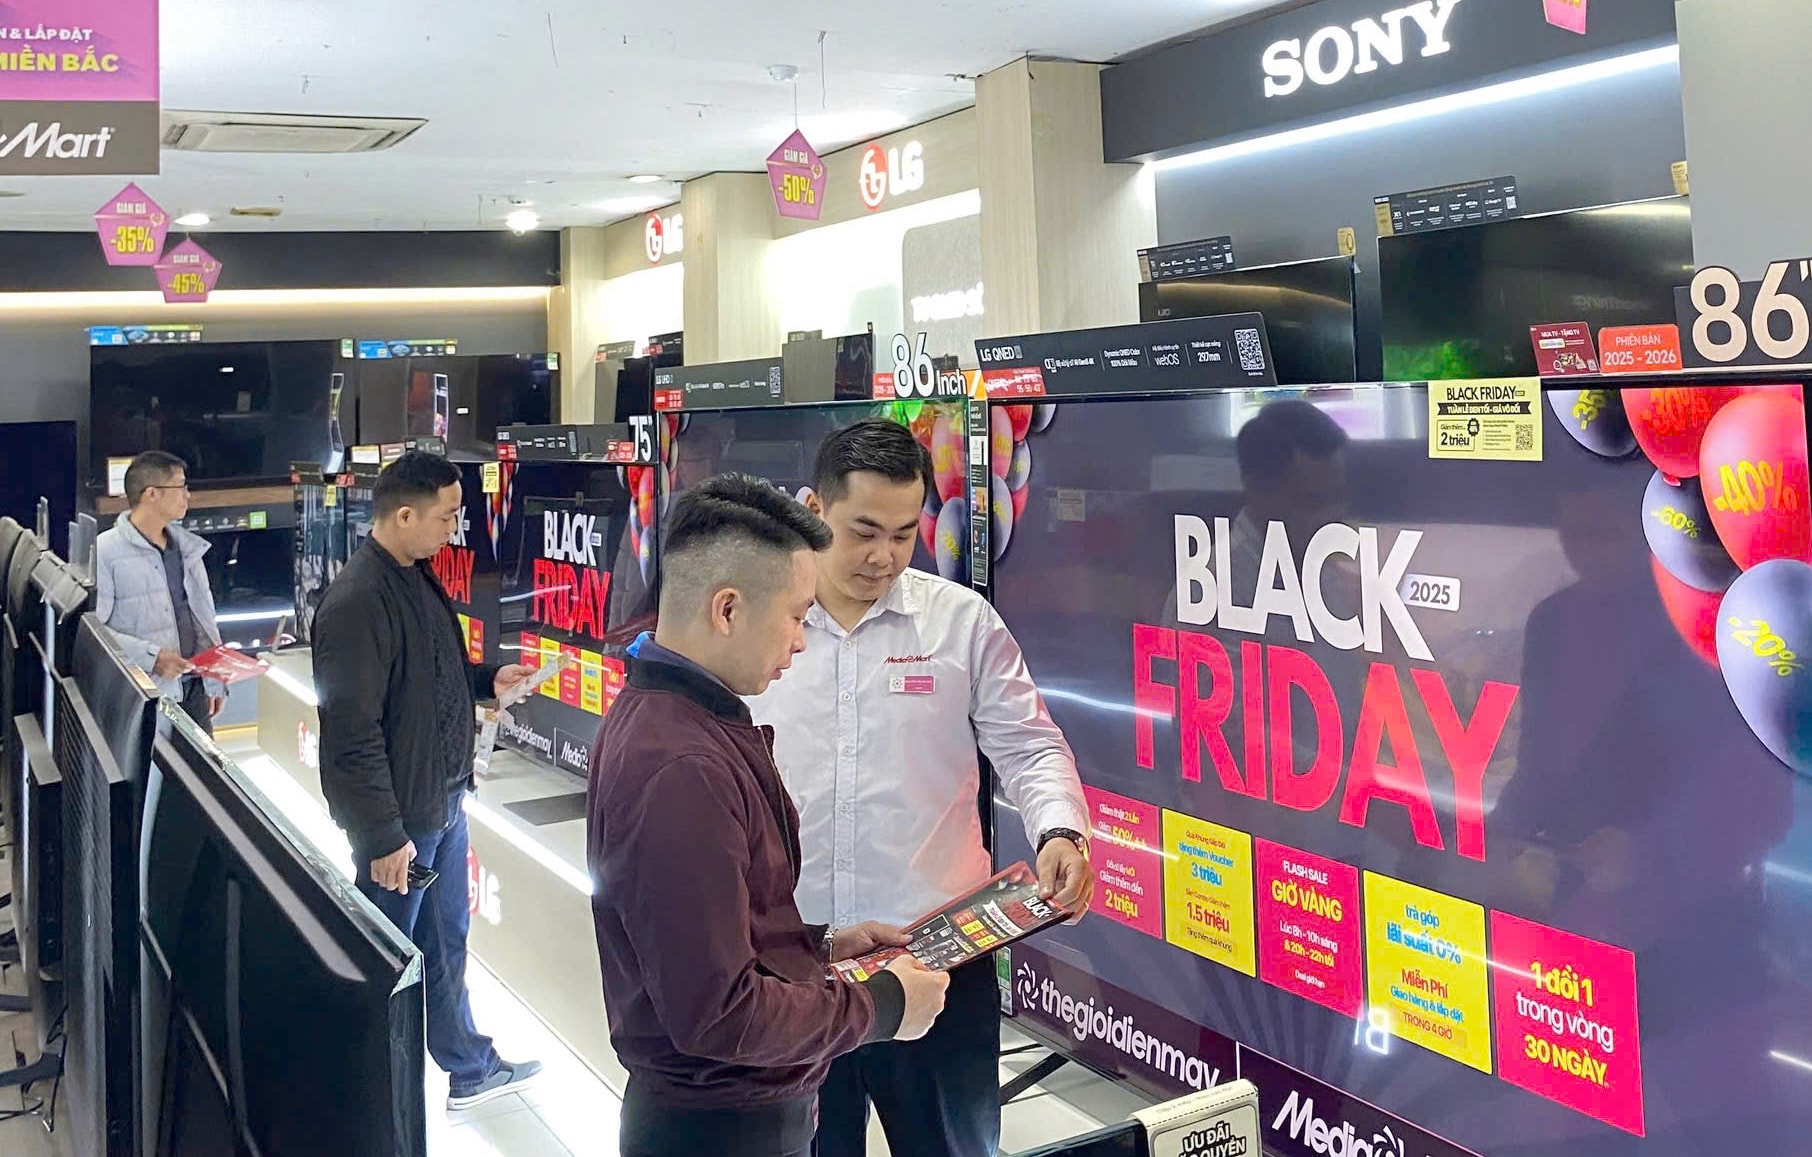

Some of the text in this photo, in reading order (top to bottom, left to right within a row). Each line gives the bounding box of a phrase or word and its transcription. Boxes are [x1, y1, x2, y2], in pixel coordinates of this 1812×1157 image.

[25, 23, 57, 40] LẮP
[58, 26, 93, 44] ĐẶT
[1262, 0, 1461, 97] SONY
[62, 45, 119, 72] BẮC
[0, 122, 112, 158] Mart
[889, 140, 924, 196] LG
[778, 173, 816, 205] -50%
[109, 226, 154, 253] -35%
[167, 273, 205, 294] -45%
[980, 346, 1014, 362] LG QNED
[1615, 332, 1661, 346] PHIÊN BẢN
[891, 332, 935, 398] 86
[936, 369, 968, 396] Inch
[1155, 353, 1180, 366] webOS
[1605, 351, 1634, 366] 2025
[1645, 349, 1677, 365] 2026
[1446, 385, 1516, 401] BLACK FRIDAY
[1441, 432, 1448, 446] 2
[1449, 432, 1470, 448] triệu
[1713, 459, 1798, 514] -40%
[544, 510, 597, 567] BLACK
[534, 558, 611, 640] FRIDAY
[1174, 514, 1451, 661] BLACK 2025
[1728, 614, 1803, 678] -20%
[1132, 622, 1520, 862] FRIDAY
[1191, 861, 1223, 887] 3 triệu
[1282, 860, 1329, 886] FLASH SALE
[1105, 889, 1139, 918] 2 triệu
[1271, 878, 1343, 922] GIỜ VÀNG
[1186, 901, 1230, 933] 1.5 triệu
[1279, 919, 1293, 934] Lúc
[1406, 904, 1440, 929] trả góp
[1436, 938, 1462, 965] 0%
[1401, 967, 1449, 999] Miễn Phí
[1391, 985, 1408, 1001] Giao
[1408, 990, 1429, 1012] hàng
[1429, 999, 1437, 1012] &
[1040, 977, 1220, 1091] thegioidienmay
[1402, 1011, 1453, 1040] TRONG 4 GIỜ
[1516, 991, 1615, 1054] trong vòng
[1524, 1034, 1608, 1086] 30 NGÀY
[1183, 1121, 1230, 1153] ƯU ĐÃI
